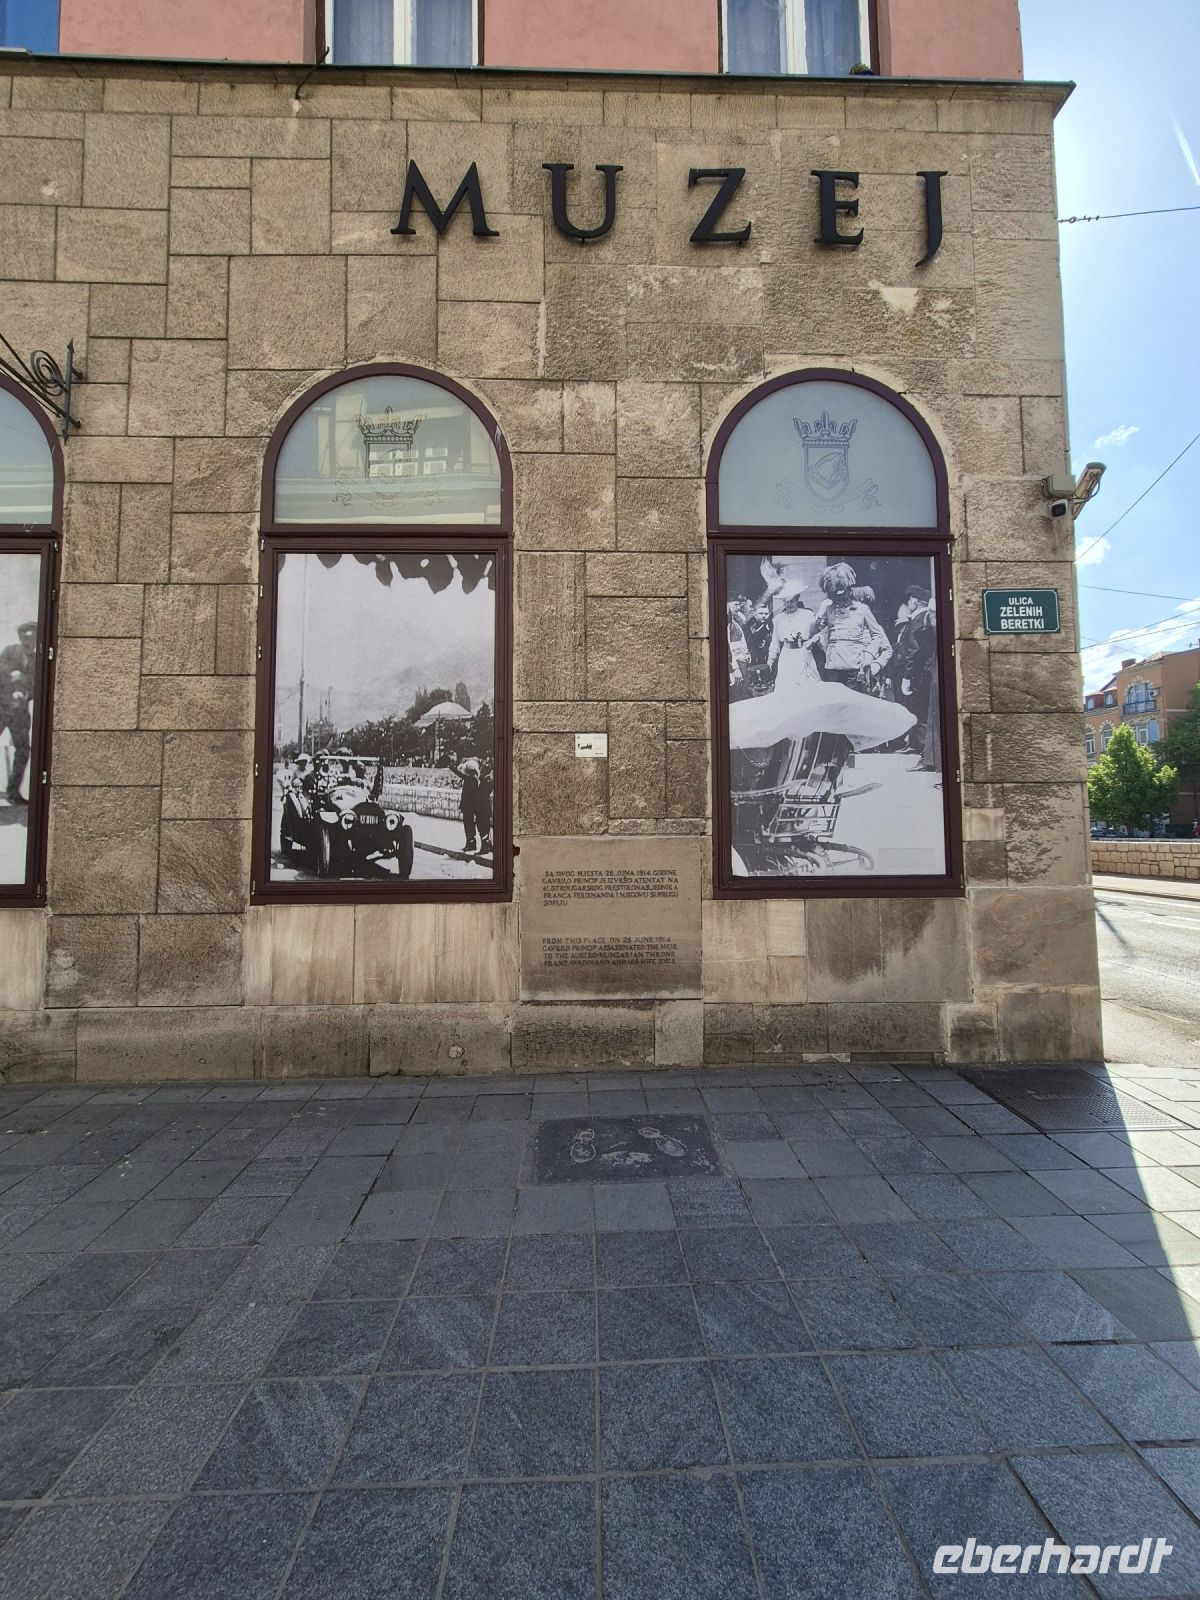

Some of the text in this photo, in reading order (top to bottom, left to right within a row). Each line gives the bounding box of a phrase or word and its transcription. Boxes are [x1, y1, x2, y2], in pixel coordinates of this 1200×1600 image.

[390, 159, 948, 268] MUZEJ
[1008, 597, 1034, 605] ULICA
[1000, 606, 1043, 617] ZELENIH
[1000, 618, 1045, 630] BERETKI
[545, 870, 554, 878] SA
[616, 869, 635, 877] JUNA
[653, 869, 677, 877] GODINE
[542, 877, 571, 885] GAVRILO
[668, 876, 679, 884] NA
[574, 891, 615, 899] FERDINANDA
[543, 937, 562, 945] FROM
[609, 936, 620, 944] ON
[622, 936, 632, 944] 28
[634, 936, 653, 944] JUNE
[543, 944, 571, 952] GAVRILO
[646, 943, 659, 951] THE
[660, 943, 678, 951] HEIR
[544, 952, 553, 960] TO
[555, 952, 569, 960] THE
[645, 951, 675, 959] THRONE
